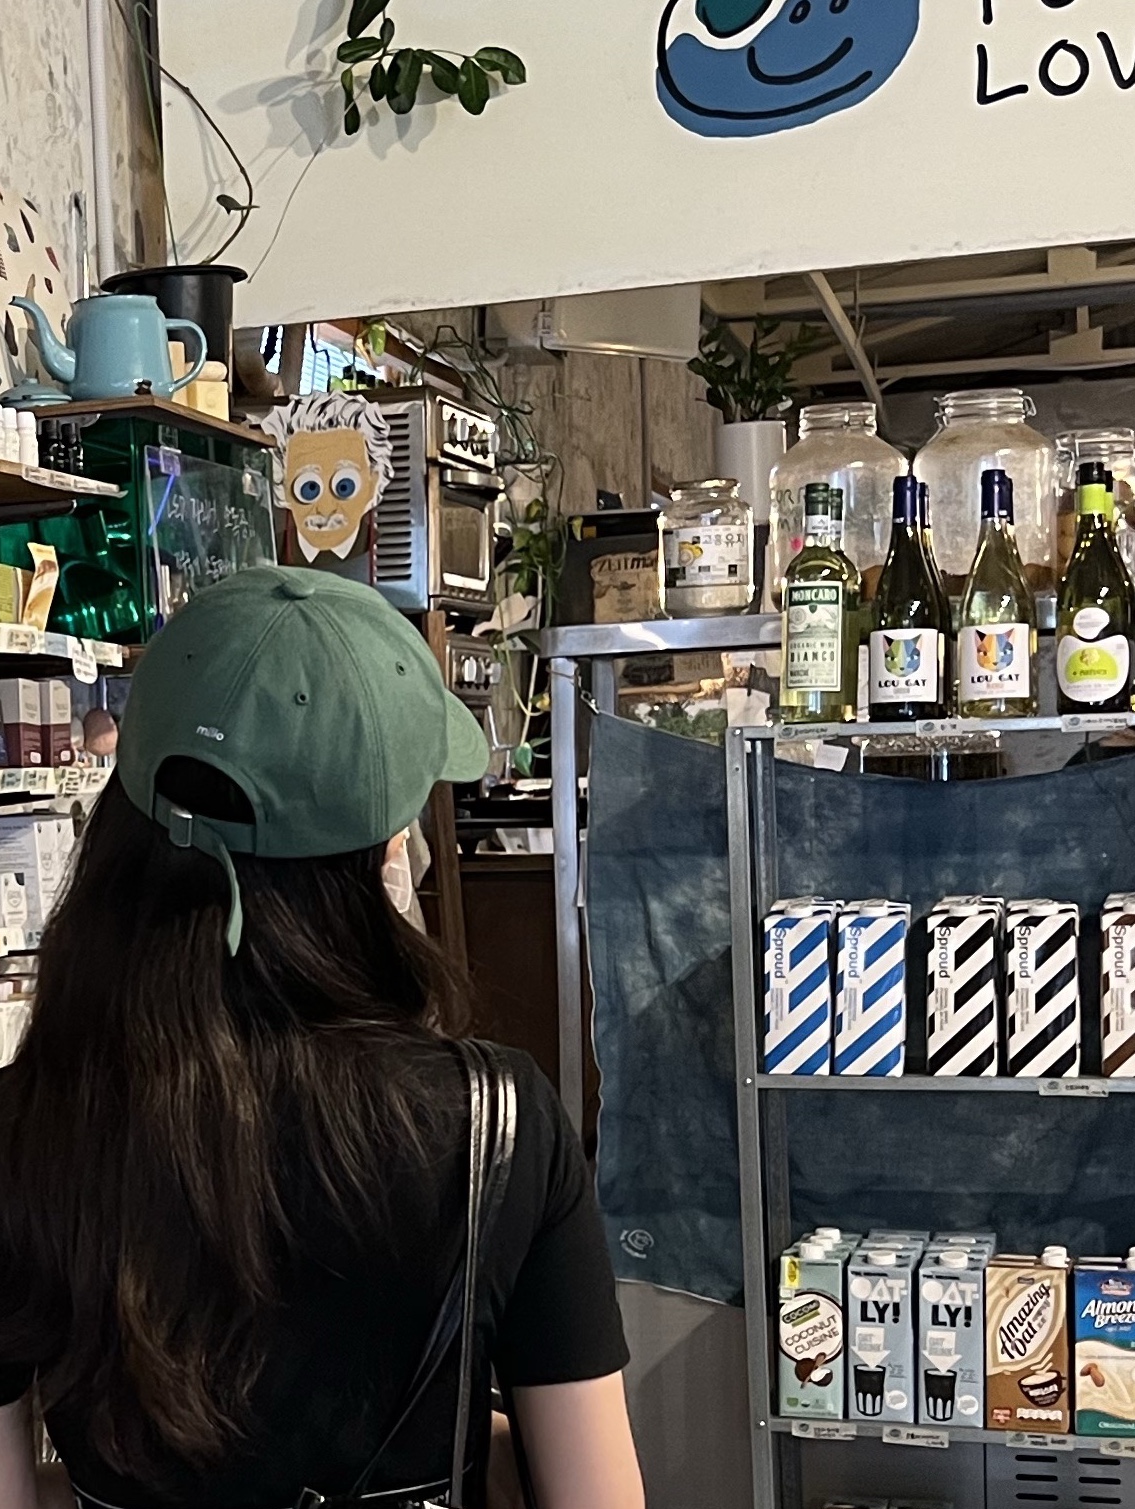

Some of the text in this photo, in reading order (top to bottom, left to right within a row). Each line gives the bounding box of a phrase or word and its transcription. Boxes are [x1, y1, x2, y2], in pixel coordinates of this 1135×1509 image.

[791, 587, 838, 602] MONCARO
[790, 650, 835, 663] BIANCO
[772, 927, 787, 980] Sproud
[848, 926, 862, 980] Sproud
[937, 926, 951, 980] Sproud
[1018, 926, 1032, 980] Sproud
[1112, 926, 1127, 980] Sproud
[784, 1313, 838, 1348] COCONUT
[860, 1301, 900, 1324] LY!
[931, 1304, 972, 1328] LY!
[999, 1282, 1052, 1360] Amazing
[793, 1326, 840, 1355] CUISINE
[1011, 1318, 1040, 1358] Oat
